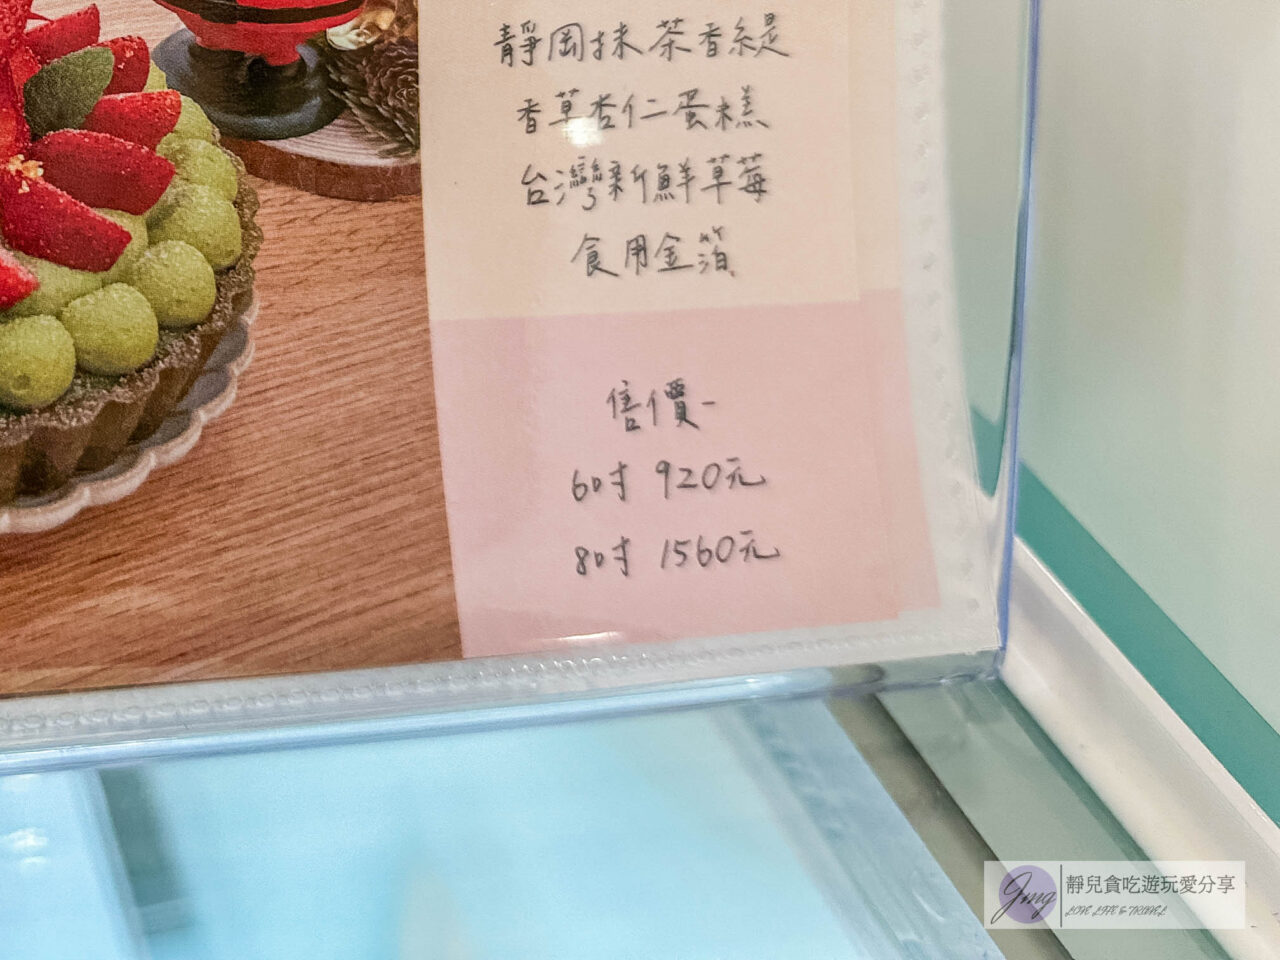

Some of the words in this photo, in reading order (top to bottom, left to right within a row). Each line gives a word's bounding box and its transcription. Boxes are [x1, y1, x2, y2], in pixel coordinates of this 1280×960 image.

[493, 13, 790, 67] 靜岡抹茶香緹
[516, 85, 770, 135] 香草杏仁蛋糕
[520, 152, 768, 211] 台灣新鮮草莓
[570, 226, 730, 277] 食用金箔
[654, 457, 767, 500] 920元
[660, 530, 781, 570] 1560元
